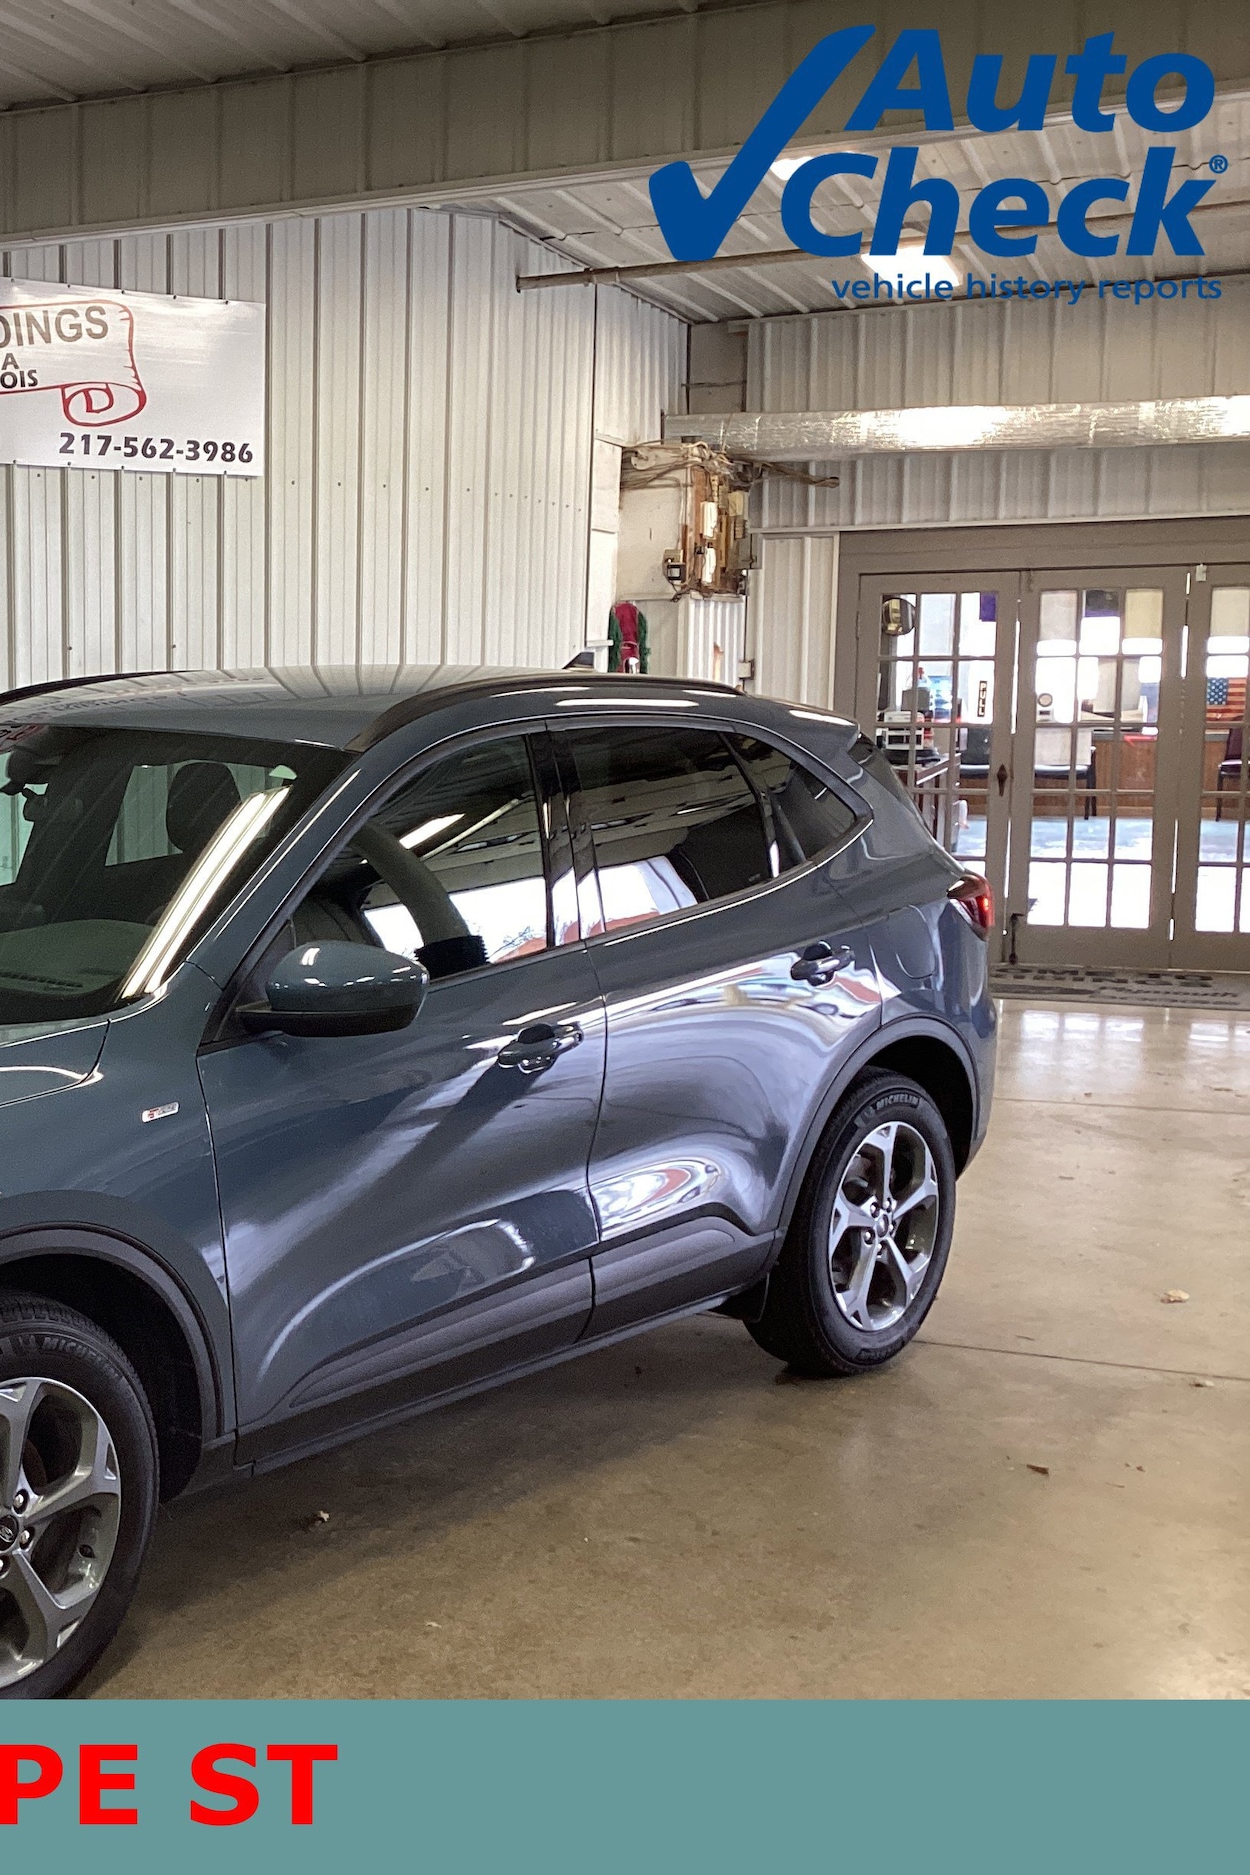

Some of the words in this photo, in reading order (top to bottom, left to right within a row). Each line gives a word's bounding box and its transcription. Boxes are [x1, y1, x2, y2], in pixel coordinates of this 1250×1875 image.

[59, 432, 253, 463] 217-562-3986
[978, 682, 987, 716] PULL
[876, 1094, 919, 1110] MICHELIN
